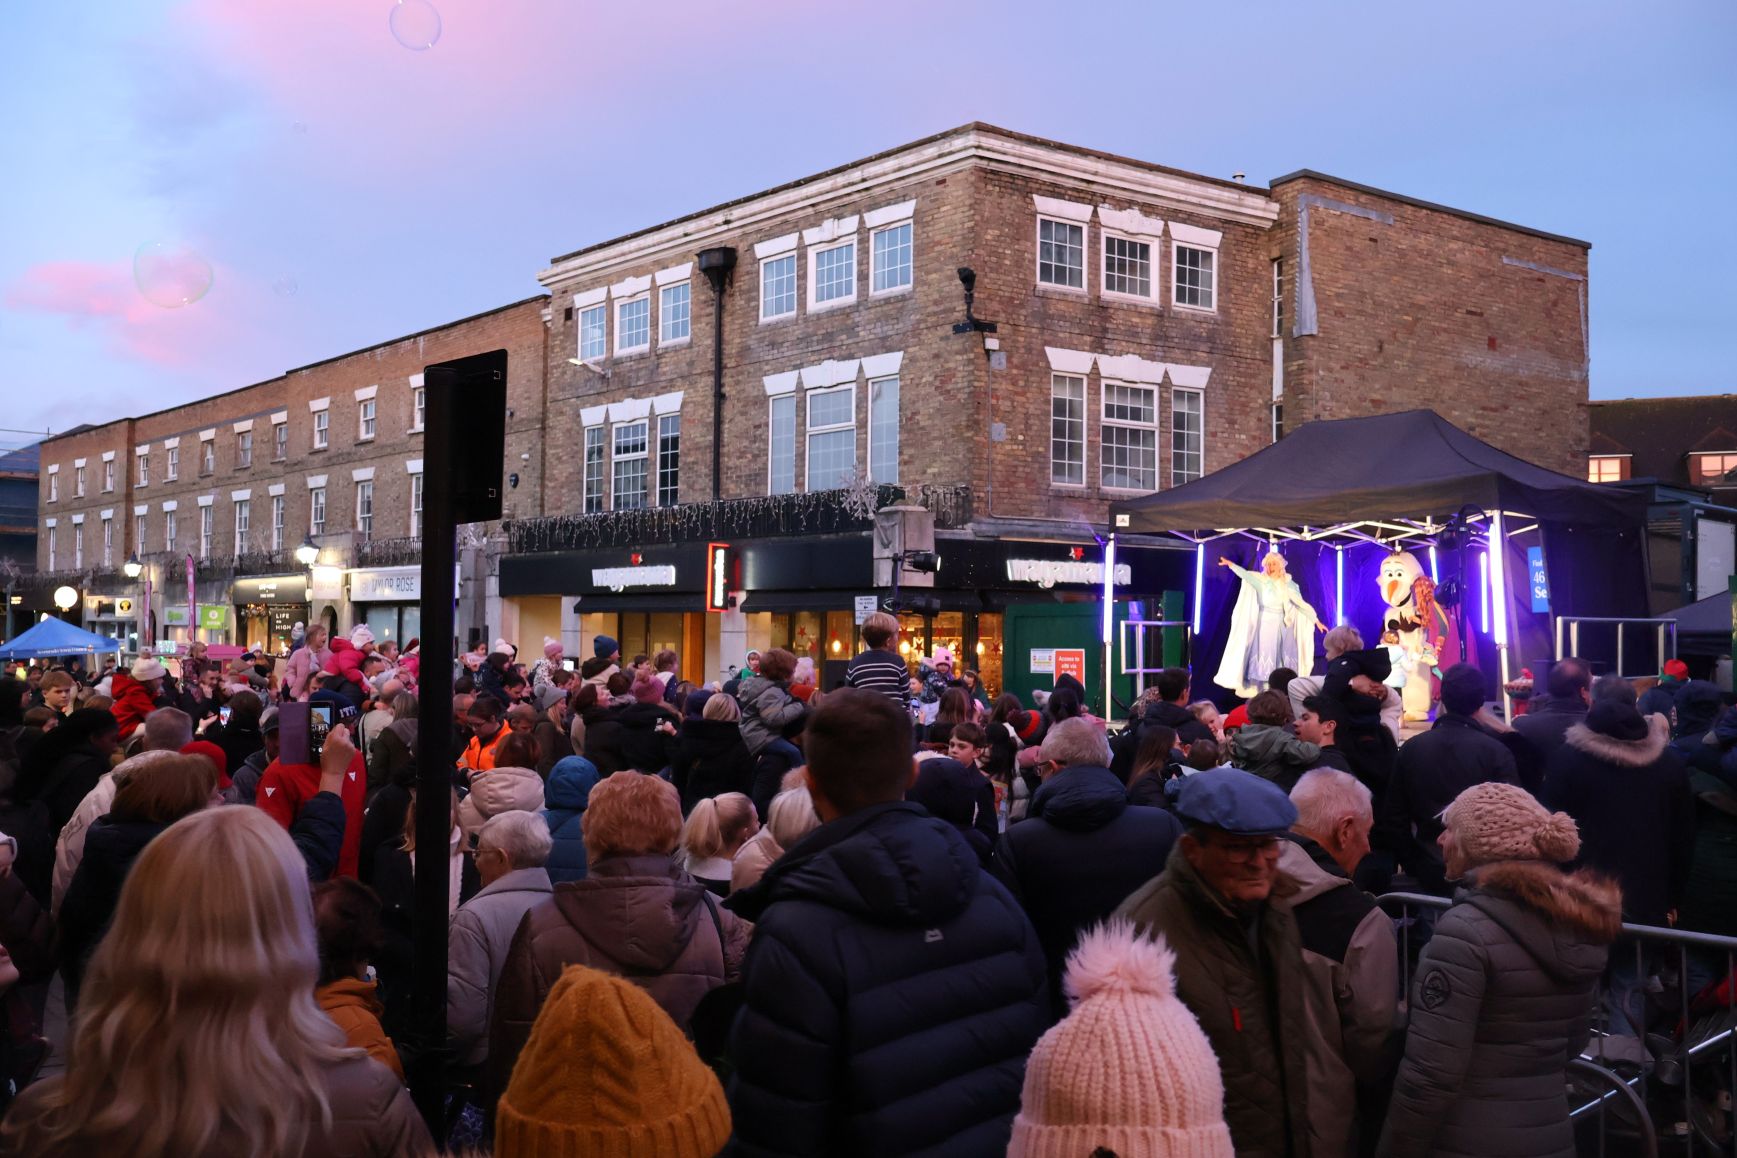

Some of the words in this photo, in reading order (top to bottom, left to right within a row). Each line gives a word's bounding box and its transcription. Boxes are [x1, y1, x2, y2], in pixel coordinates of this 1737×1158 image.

[1534, 571, 1545, 583] 46
[396, 576, 414, 592] ROSE
[275, 612, 290, 620] LIFE
